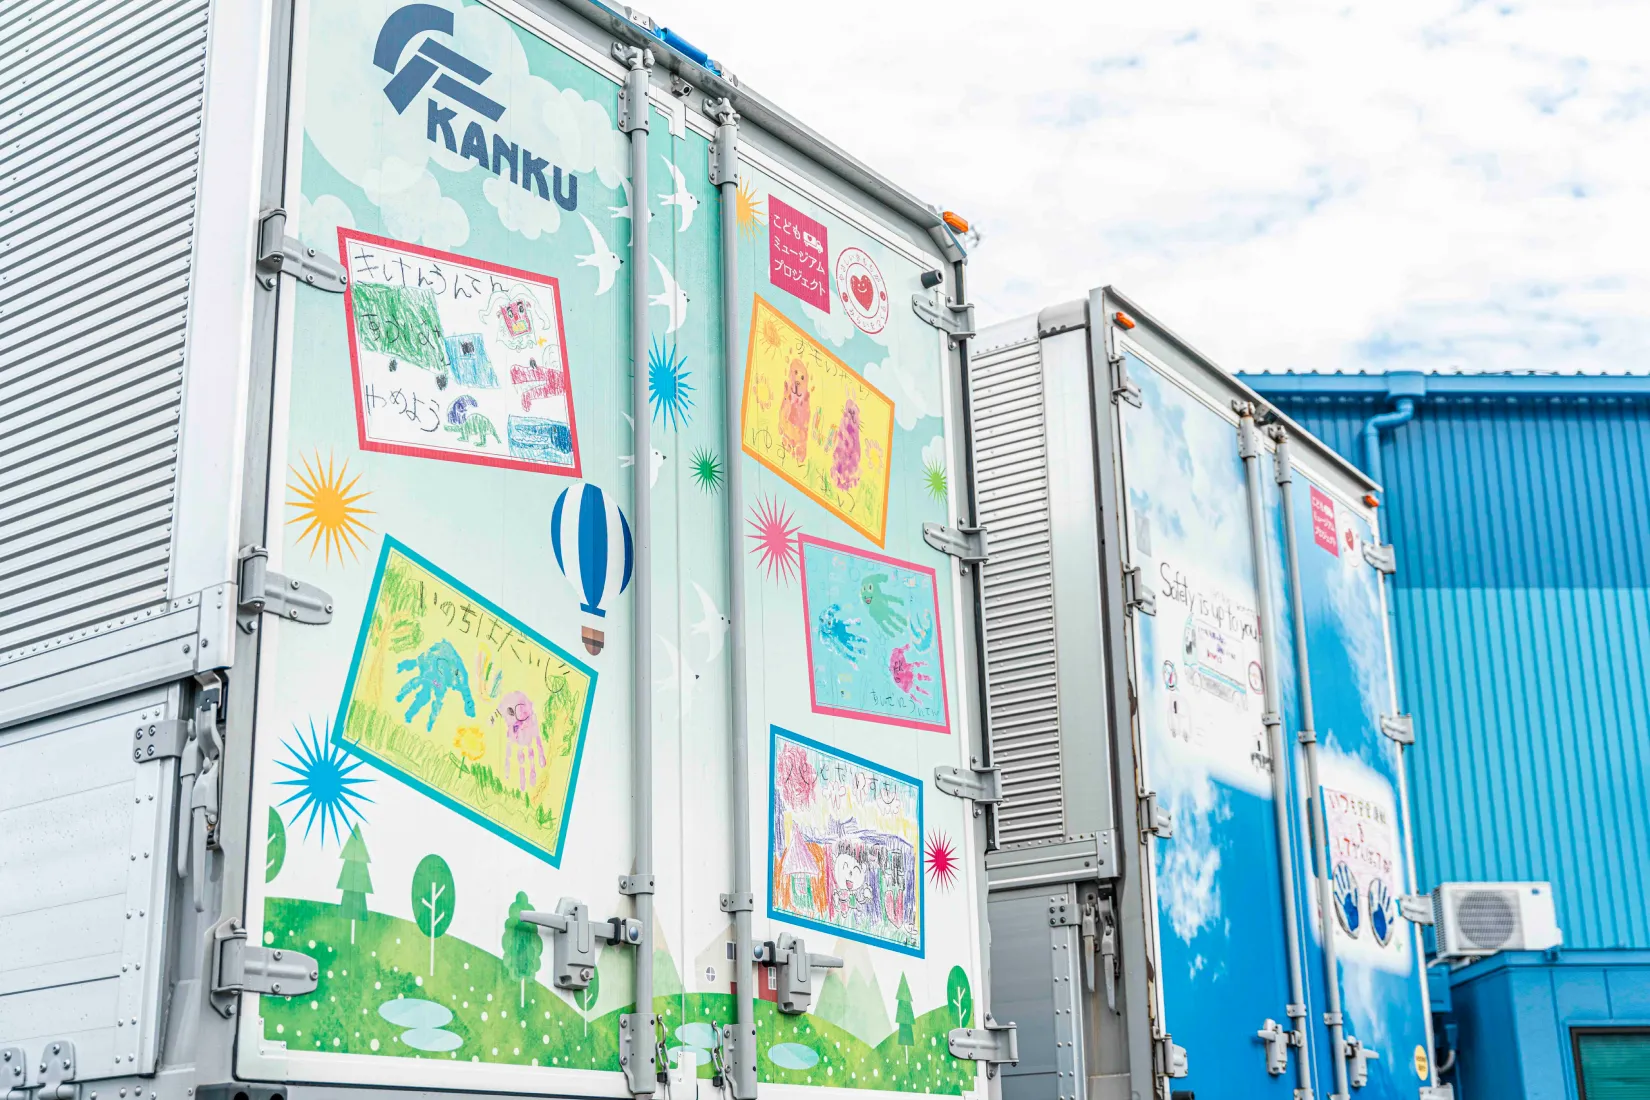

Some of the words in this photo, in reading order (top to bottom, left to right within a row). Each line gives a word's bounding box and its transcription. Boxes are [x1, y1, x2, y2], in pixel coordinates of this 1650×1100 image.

[427, 97, 578, 212] KANKU
[772, 213, 801, 239] こども
[354, 247, 509, 299] きけんうんてん
[773, 235, 826, 275] ミュージアム
[774, 259, 827, 296] プロジェクト
[364, 384, 441, 433] やめよう
[1159, 561, 1196, 613] Safety
[1197, 593, 1210, 616] is
[1211, 605, 1225, 629] up
[418, 580, 572, 694] いのちはだいじ
